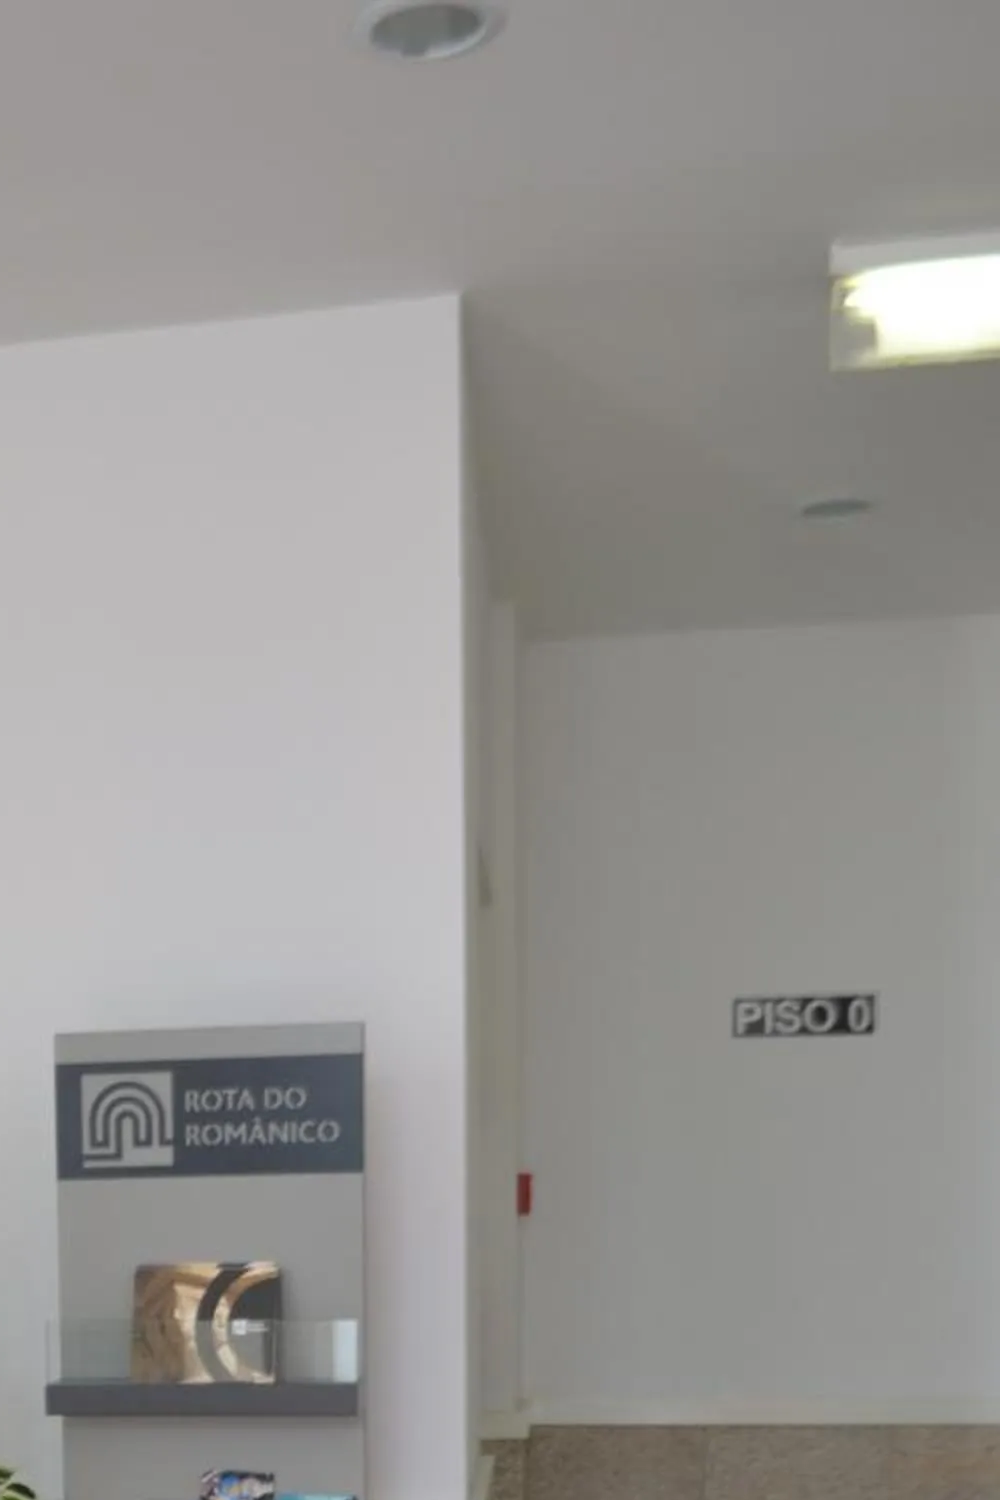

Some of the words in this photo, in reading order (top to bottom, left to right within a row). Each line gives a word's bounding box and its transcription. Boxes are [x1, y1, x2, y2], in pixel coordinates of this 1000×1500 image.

[736, 1000, 837, 1035] PISO
[184, 1088, 254, 1112] ROTA
[263, 1087, 307, 1110] DO
[185, 1118, 341, 1146] ROMÂNICO
